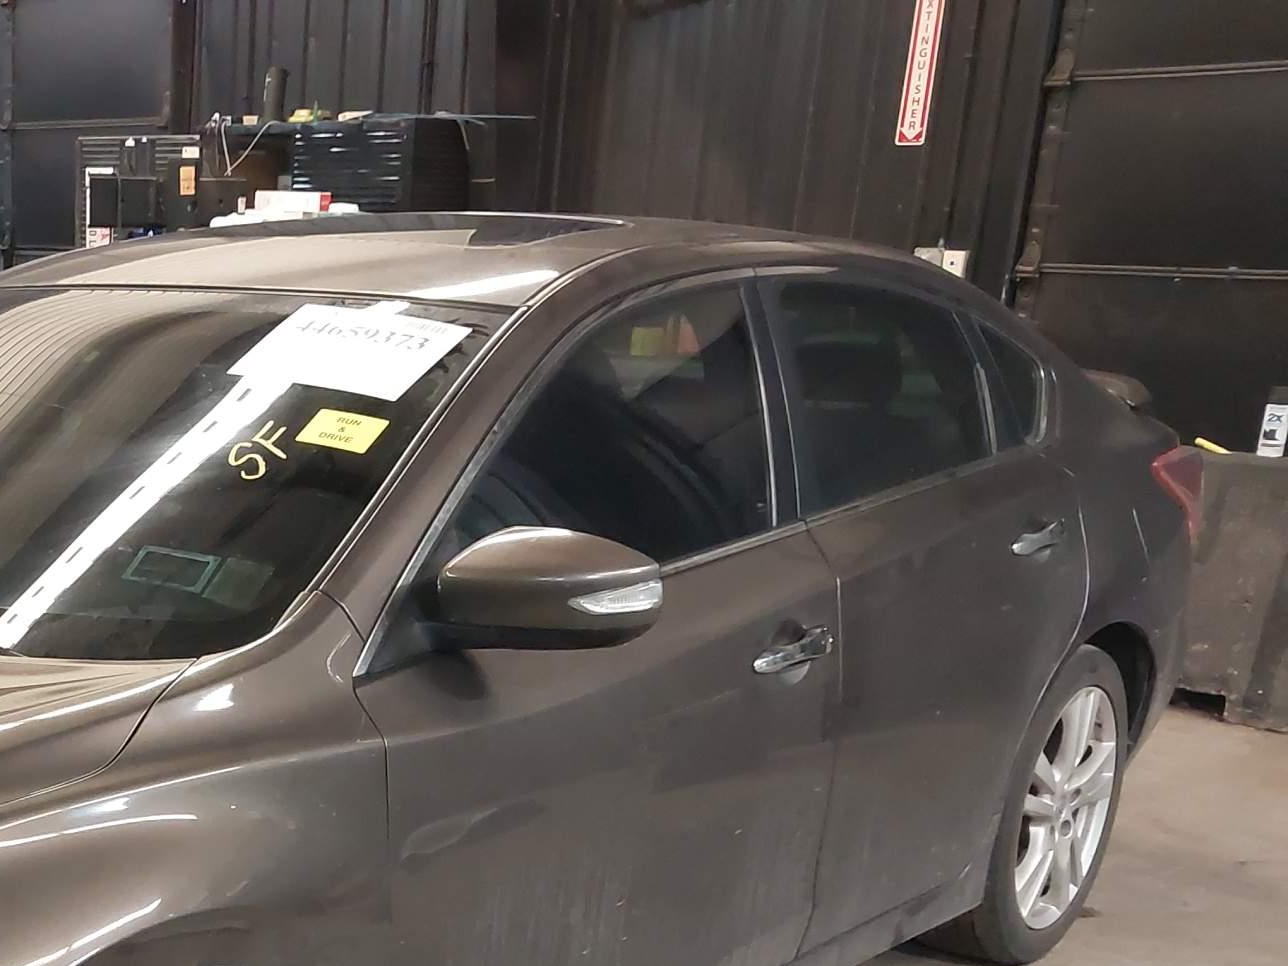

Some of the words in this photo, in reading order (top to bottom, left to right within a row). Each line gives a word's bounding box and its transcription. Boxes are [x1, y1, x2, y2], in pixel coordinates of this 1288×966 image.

[296, 319, 432, 351] 44659373
[336, 416, 363, 427] RUN
[337, 426, 347, 434] &
[317, 431, 355, 444] DRIVE
[227, 419, 289, 480] SF
